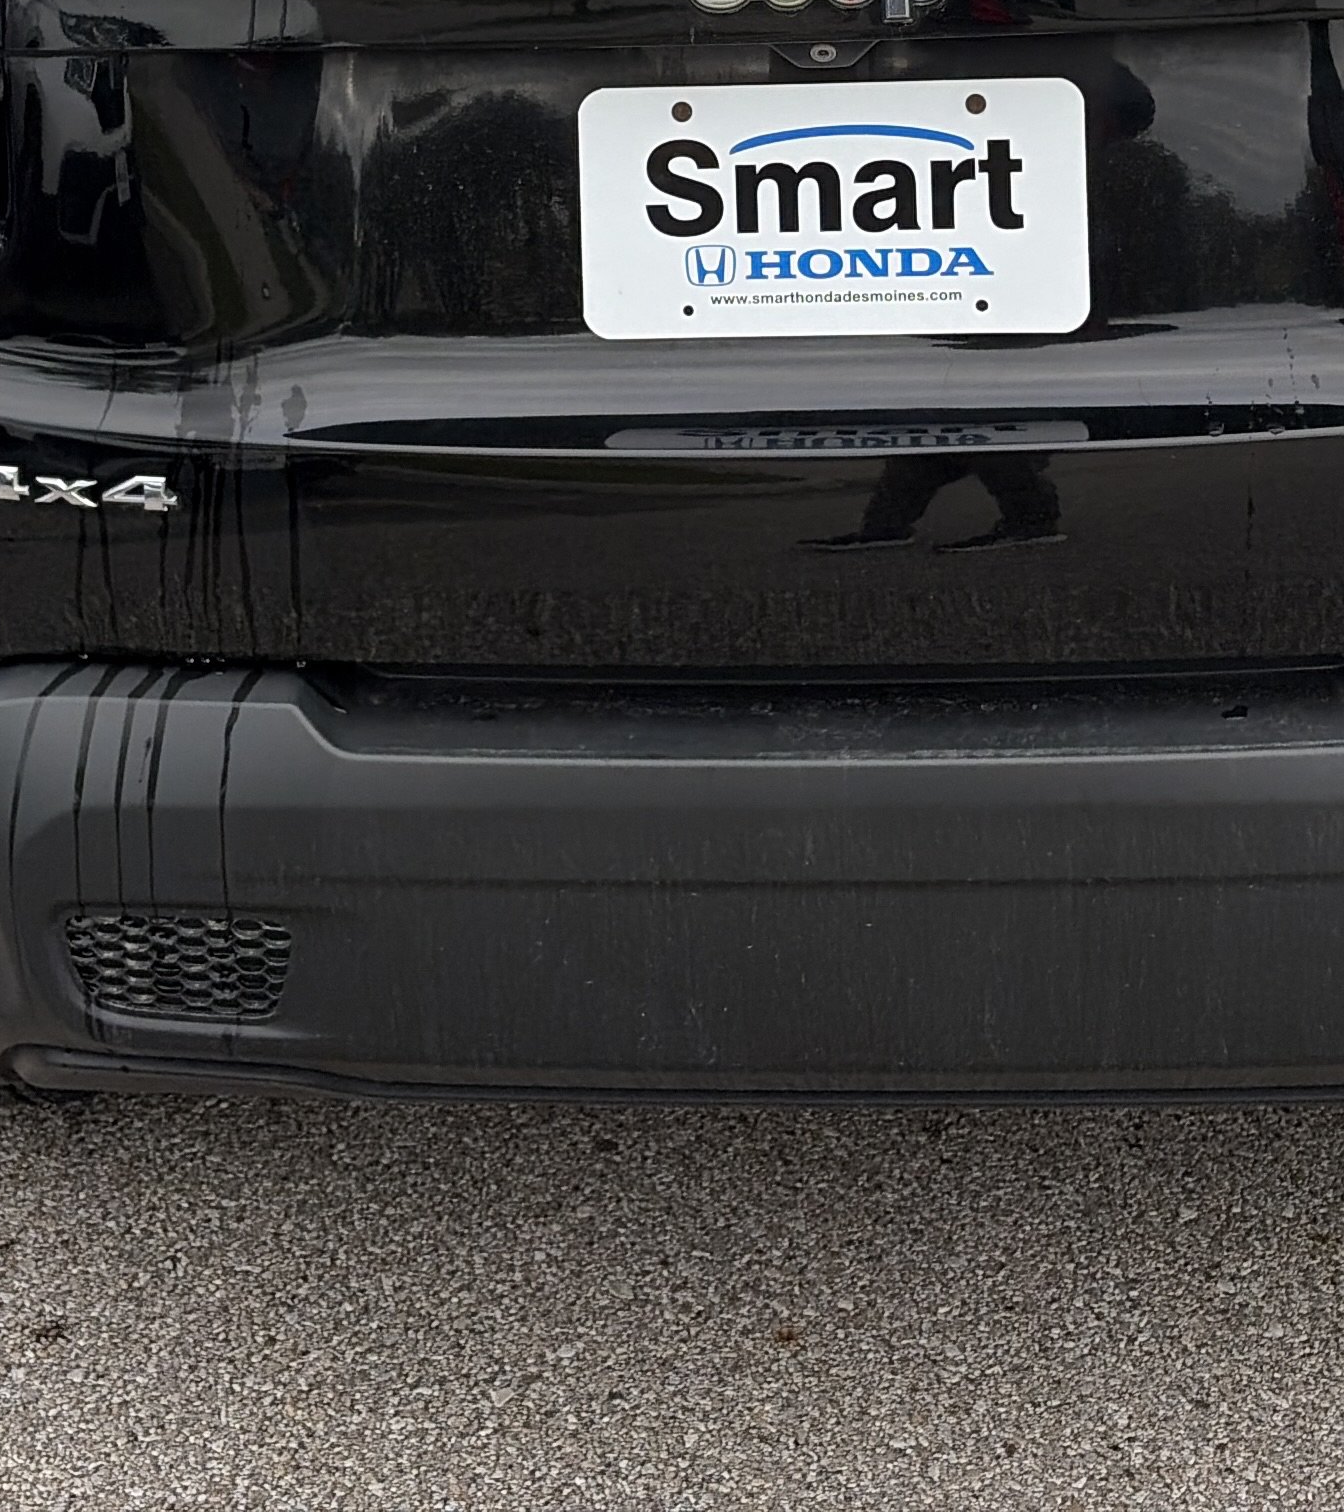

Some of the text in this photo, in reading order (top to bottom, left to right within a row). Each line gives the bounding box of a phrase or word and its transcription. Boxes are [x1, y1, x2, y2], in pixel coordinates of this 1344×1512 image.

[645, 138, 1025, 238] Smart
[744, 246, 995, 280] HONDA
[709, 289, 963, 306] www.smarthondadesmoines.com
